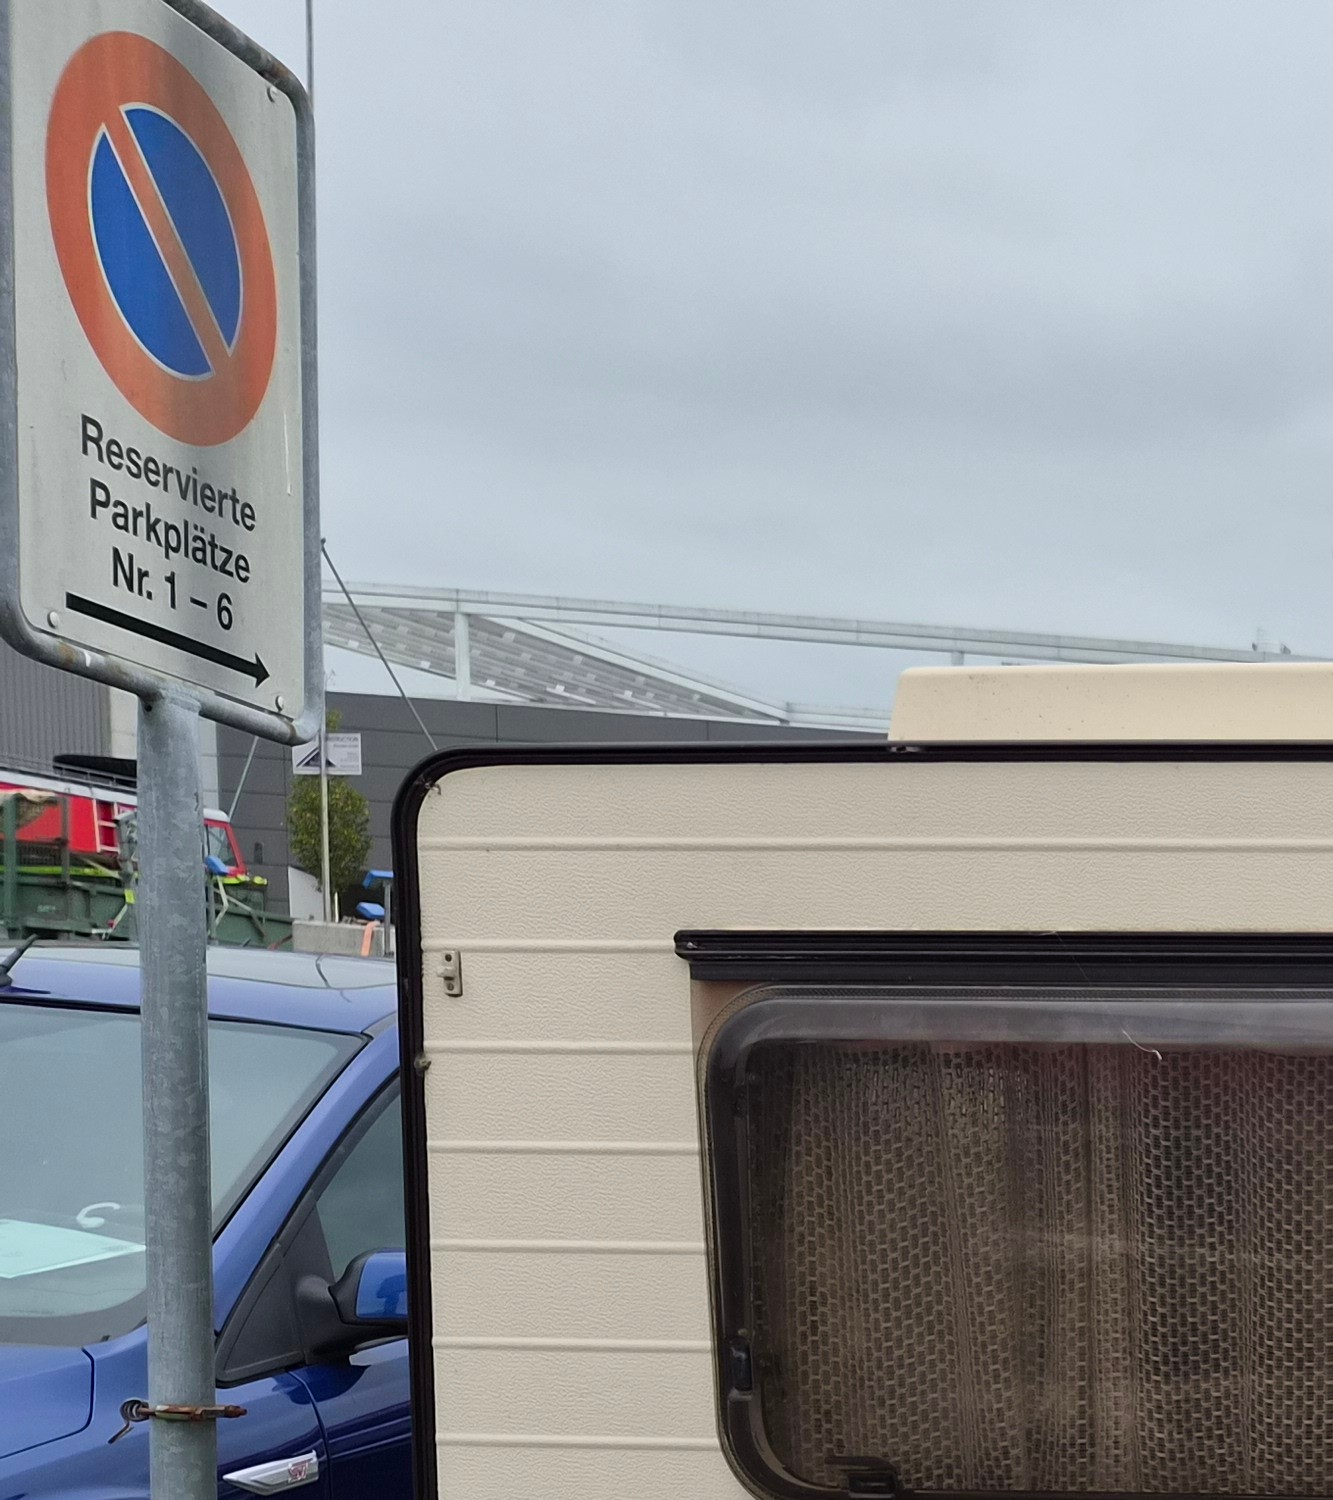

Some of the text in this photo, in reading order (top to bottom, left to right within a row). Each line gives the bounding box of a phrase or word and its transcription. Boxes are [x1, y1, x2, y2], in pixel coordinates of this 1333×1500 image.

[81, 413, 256, 532] Reservierte
[90, 477, 251, 583] Parkplätze
[112, 546, 153, 600] Nr.
[164, 571, 176, 609] 1
[217, 592, 233, 631] 6
